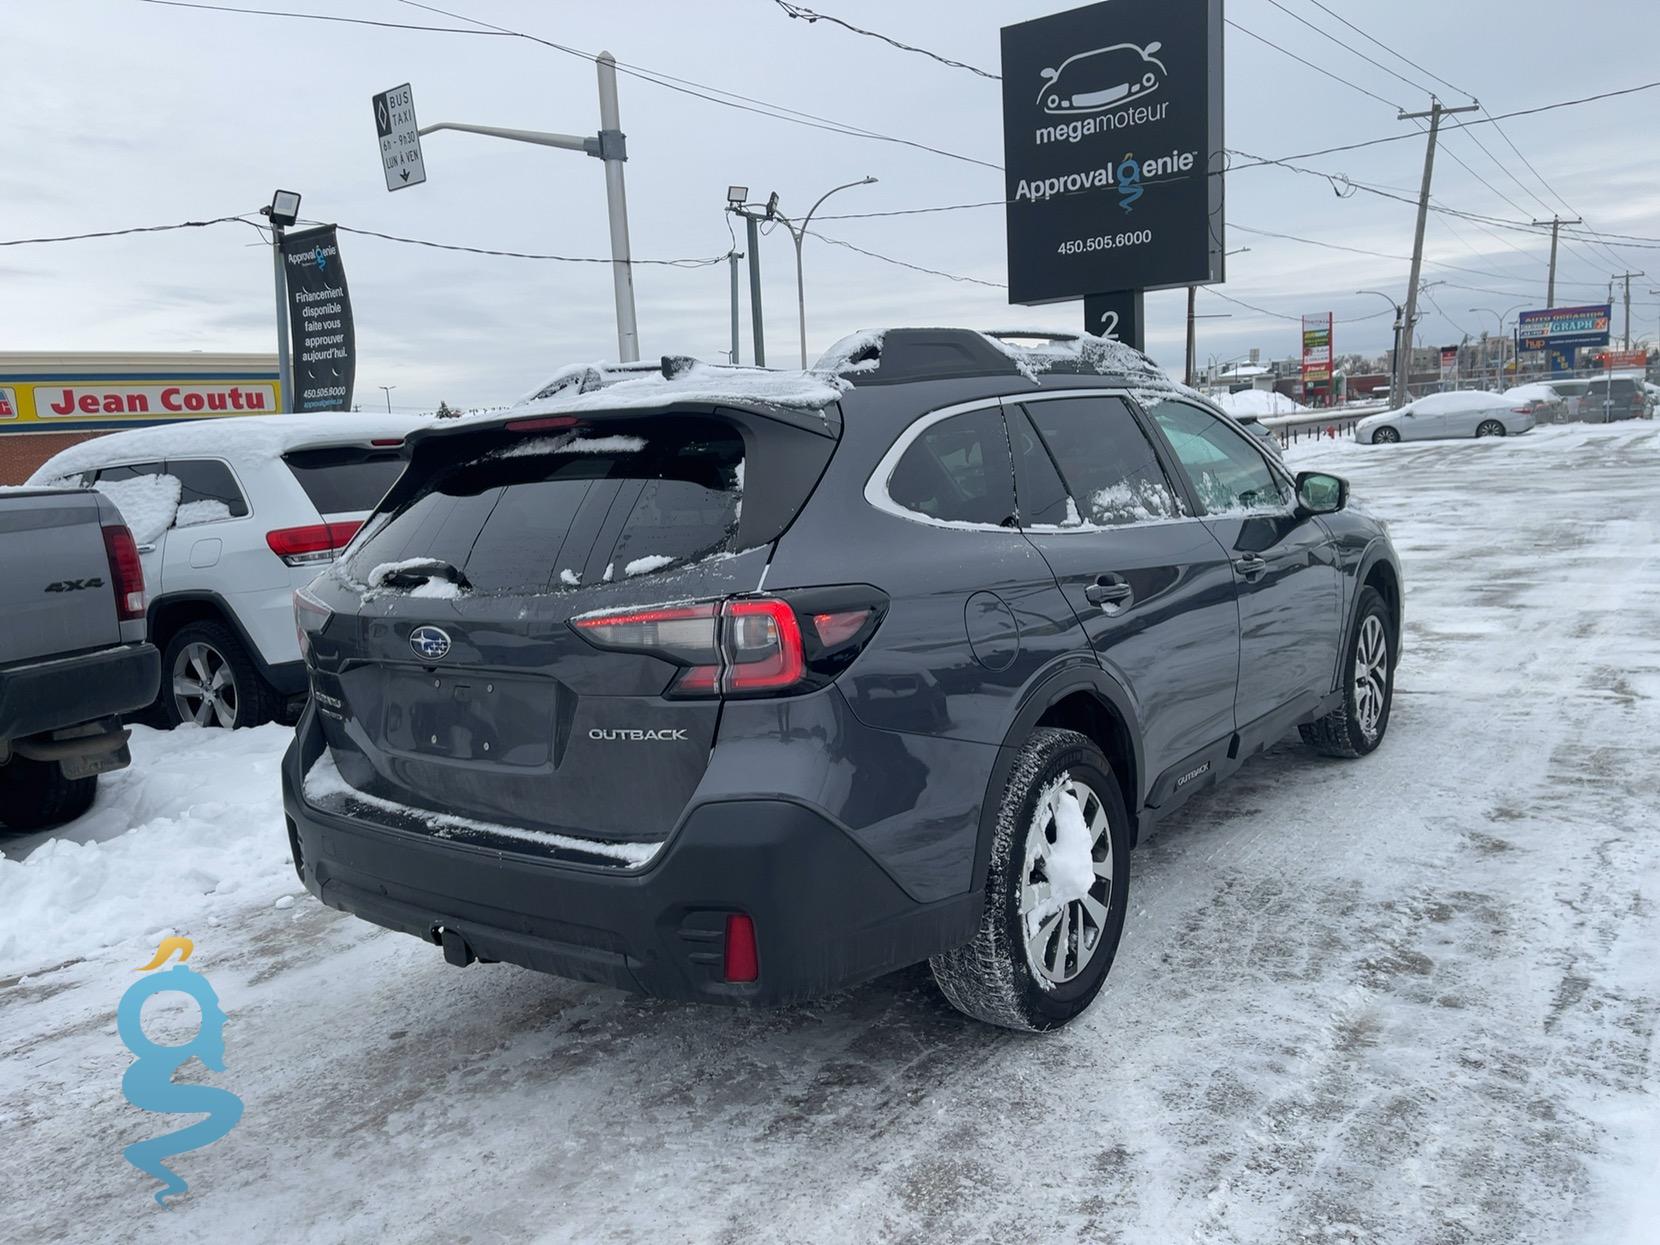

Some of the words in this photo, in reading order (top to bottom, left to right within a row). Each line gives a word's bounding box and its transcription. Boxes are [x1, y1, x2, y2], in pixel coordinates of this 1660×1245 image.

[389, 91, 409, 109] BUS
[392, 109, 412, 127] TAXI
[1035, 100, 1169, 145] megamoteur
[383, 140, 392, 152] 6h
[398, 130, 416, 146] 9h30
[385, 154, 399, 170] LUN
[405, 149, 420, 163] VEN
[1057, 229, 1152, 255] 450.505.6000
[295, 286, 344, 304] Financement
[302, 302, 342, 318] disponible
[304, 321, 323, 332] faite
[323, 319, 341, 330] vous
[1099, 310, 1120, 340] 2
[304, 334, 344, 349] approuver
[50, 389, 149, 416] Jean
[160, 386, 265, 412] Coutu
[303, 386, 346, 399] 450.505.6000
[588, 727, 690, 742] OUTBACK
[1177, 762, 1209, 787] OUTBACK
